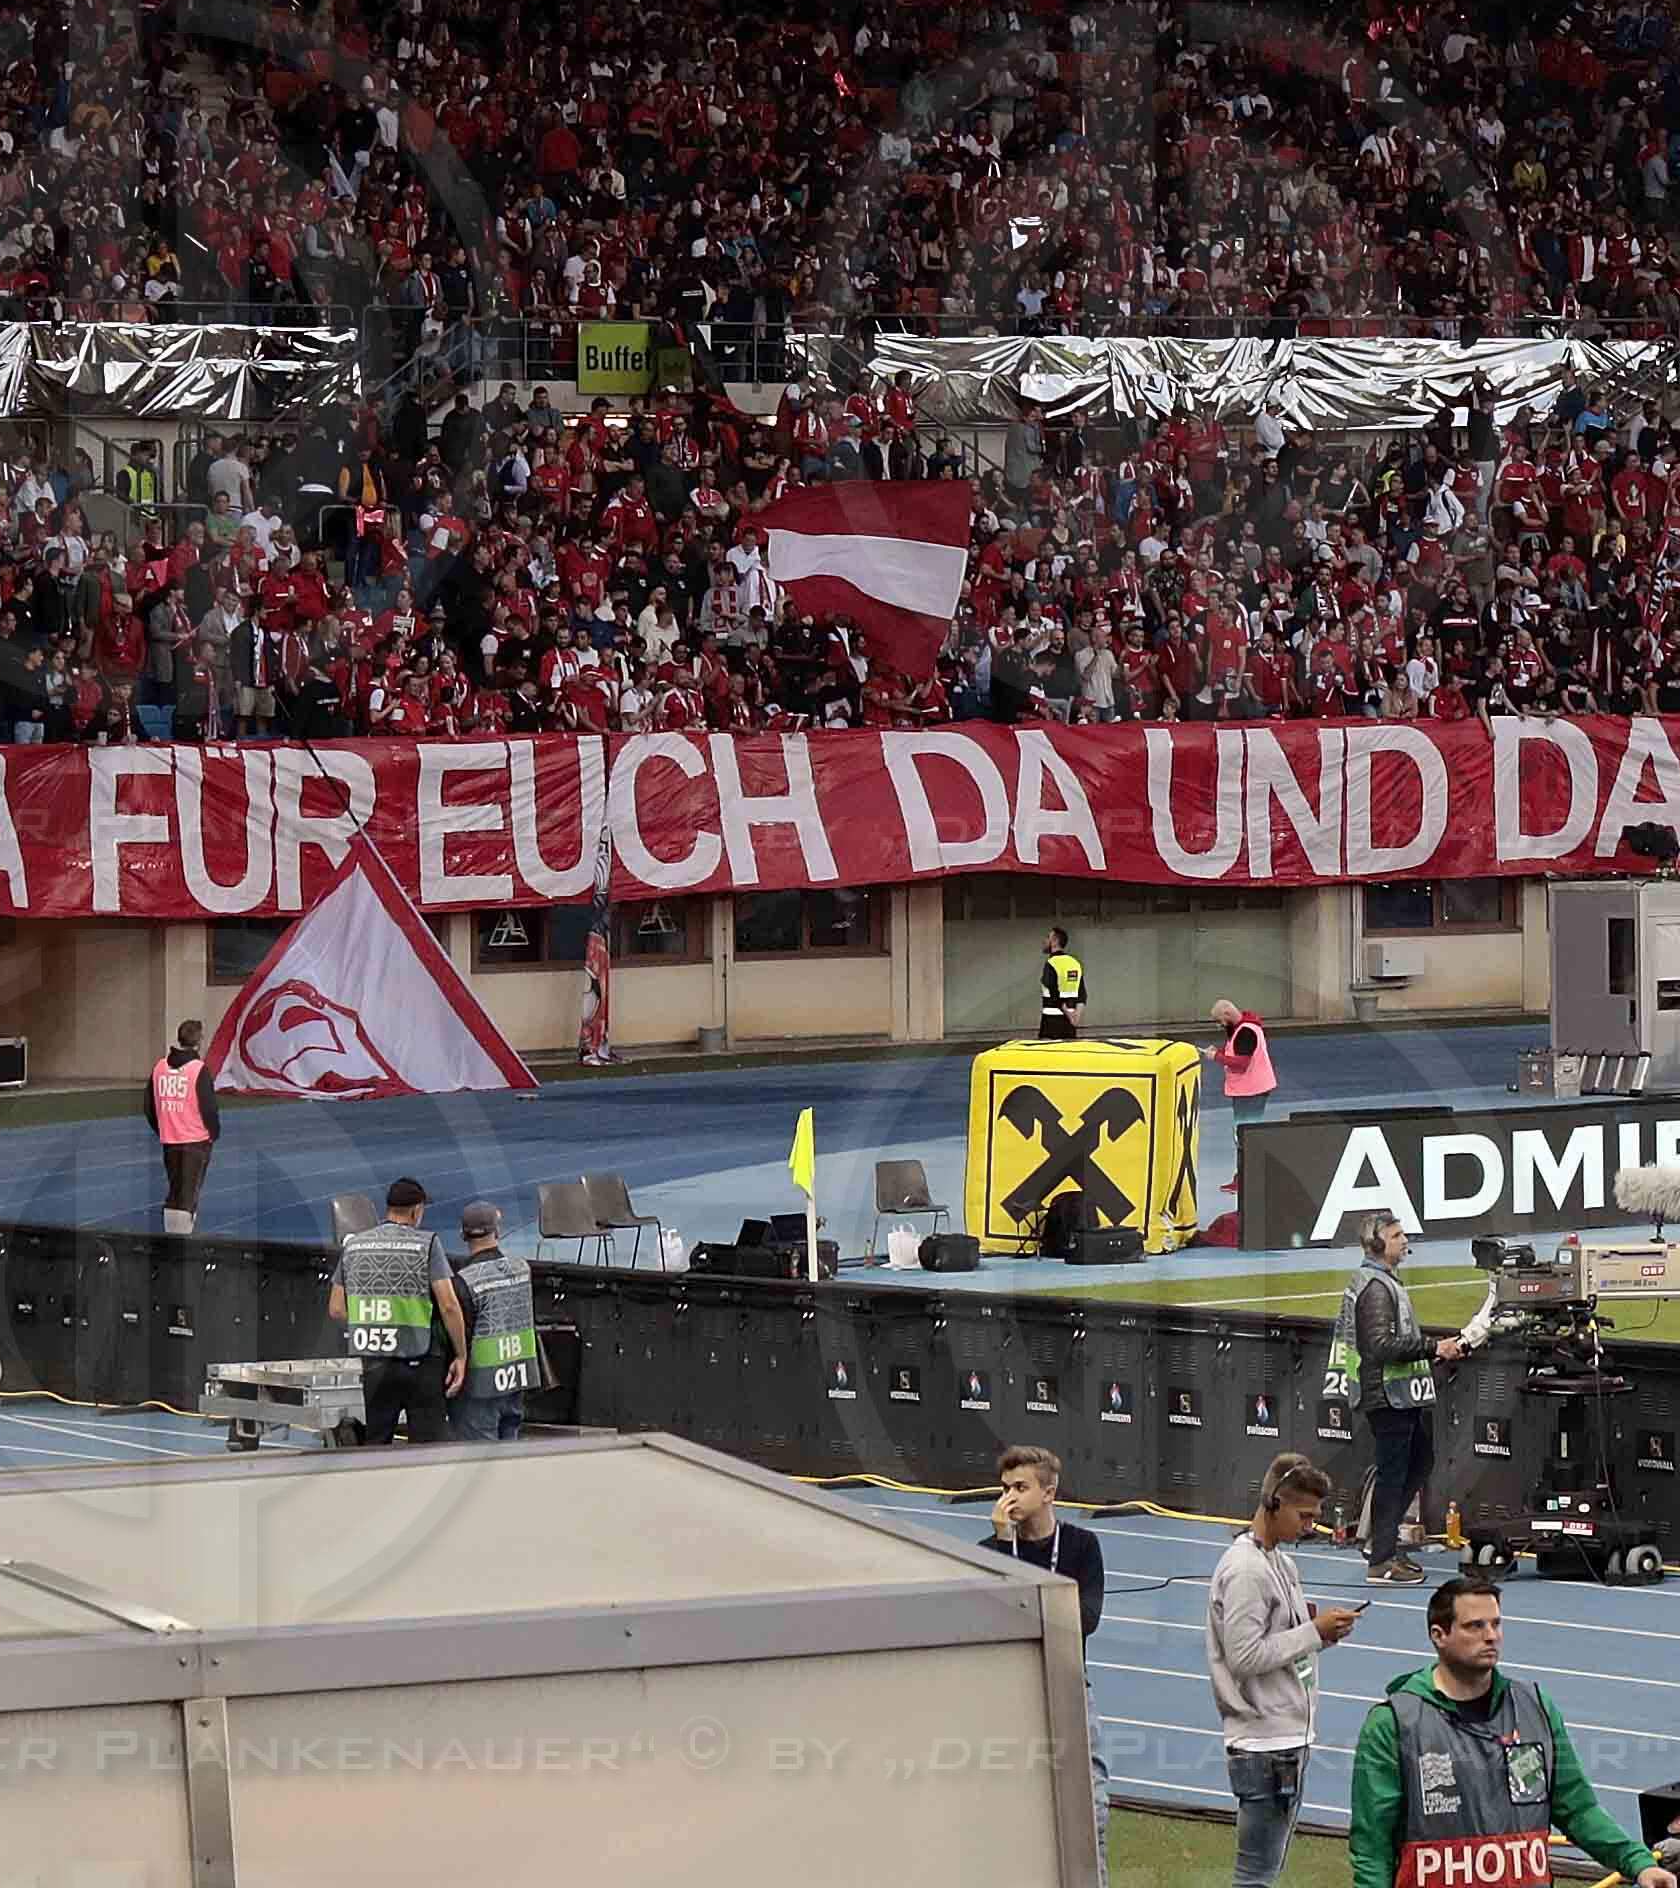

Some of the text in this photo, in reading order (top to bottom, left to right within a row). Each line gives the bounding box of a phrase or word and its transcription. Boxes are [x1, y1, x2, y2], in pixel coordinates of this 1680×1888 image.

[586, 345, 652, 372] Buffet
[90, 742, 377, 915] FÜR
[416, 732, 840, 905] EUCH
[880, 727, 1107, 874] DA
[1145, 724, 1450, 879] UND
[158, 1074, 187, 1099] 085
[1642, 1264, 1666, 1276] ORF
[1520, 1283, 1541, 1293] ORF
[358, 1298, 393, 1322] HB
[353, 1328, 398, 1352] 053
[498, 1335, 522, 1360] HB
[494, 1363, 529, 1391] 021
[1415, 1837, 1547, 1887] PHOTO
